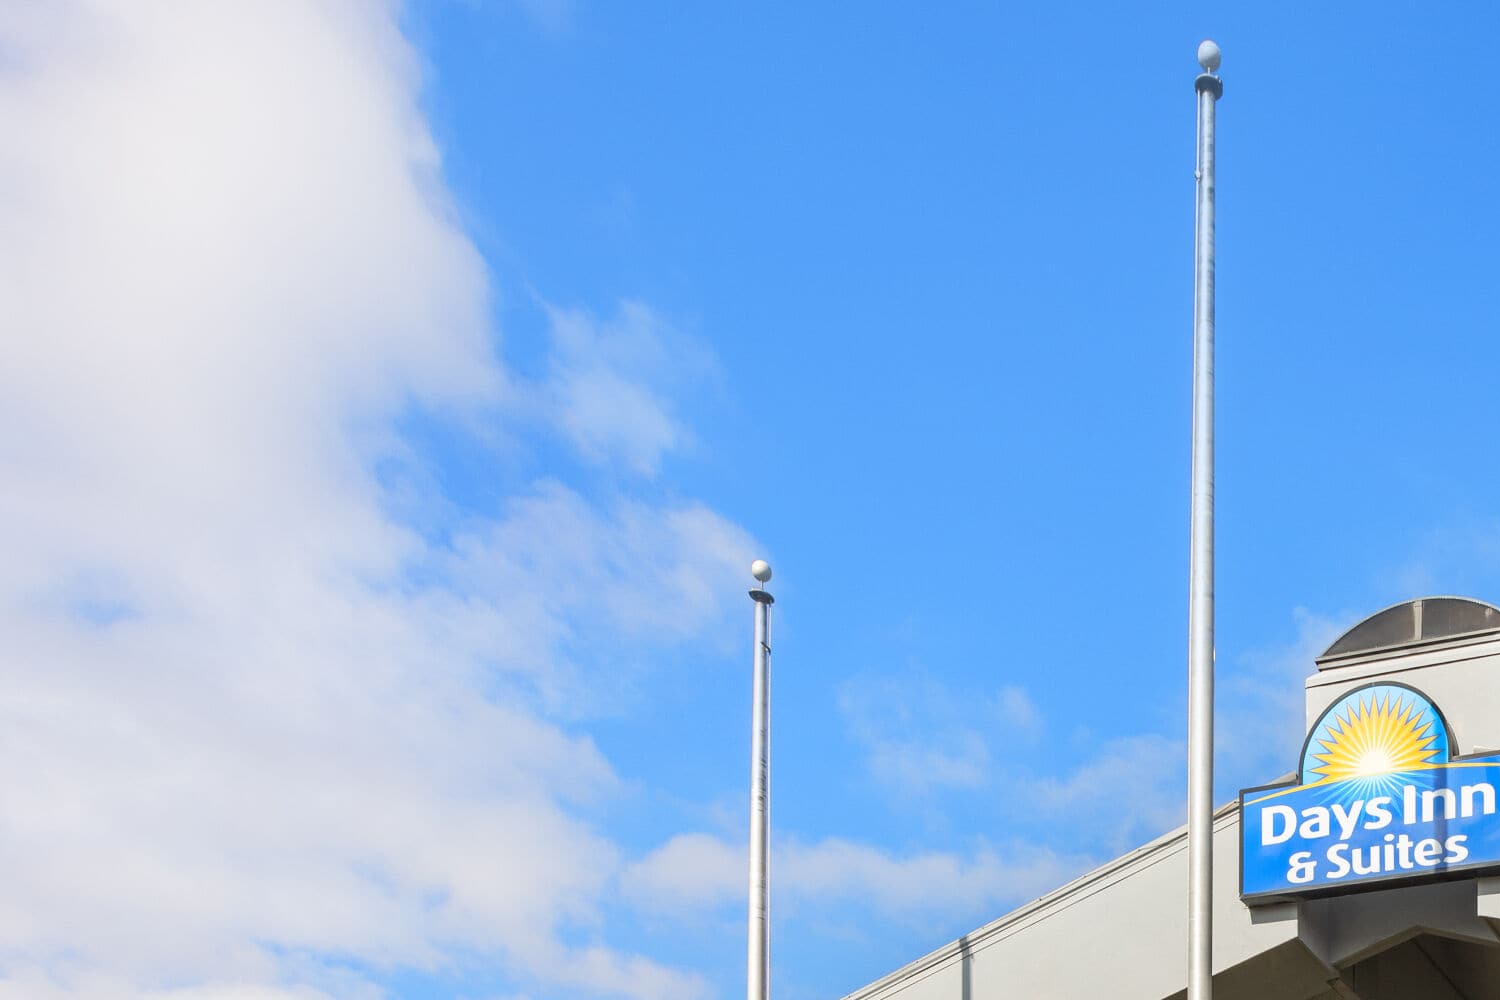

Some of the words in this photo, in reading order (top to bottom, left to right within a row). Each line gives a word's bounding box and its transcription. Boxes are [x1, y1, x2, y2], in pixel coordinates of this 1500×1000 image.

[1260, 796, 1393, 846] Days
[1403, 782, 1496, 826] Inn
[1286, 851, 1317, 884] &
[1326, 833, 1469, 879] Suites
